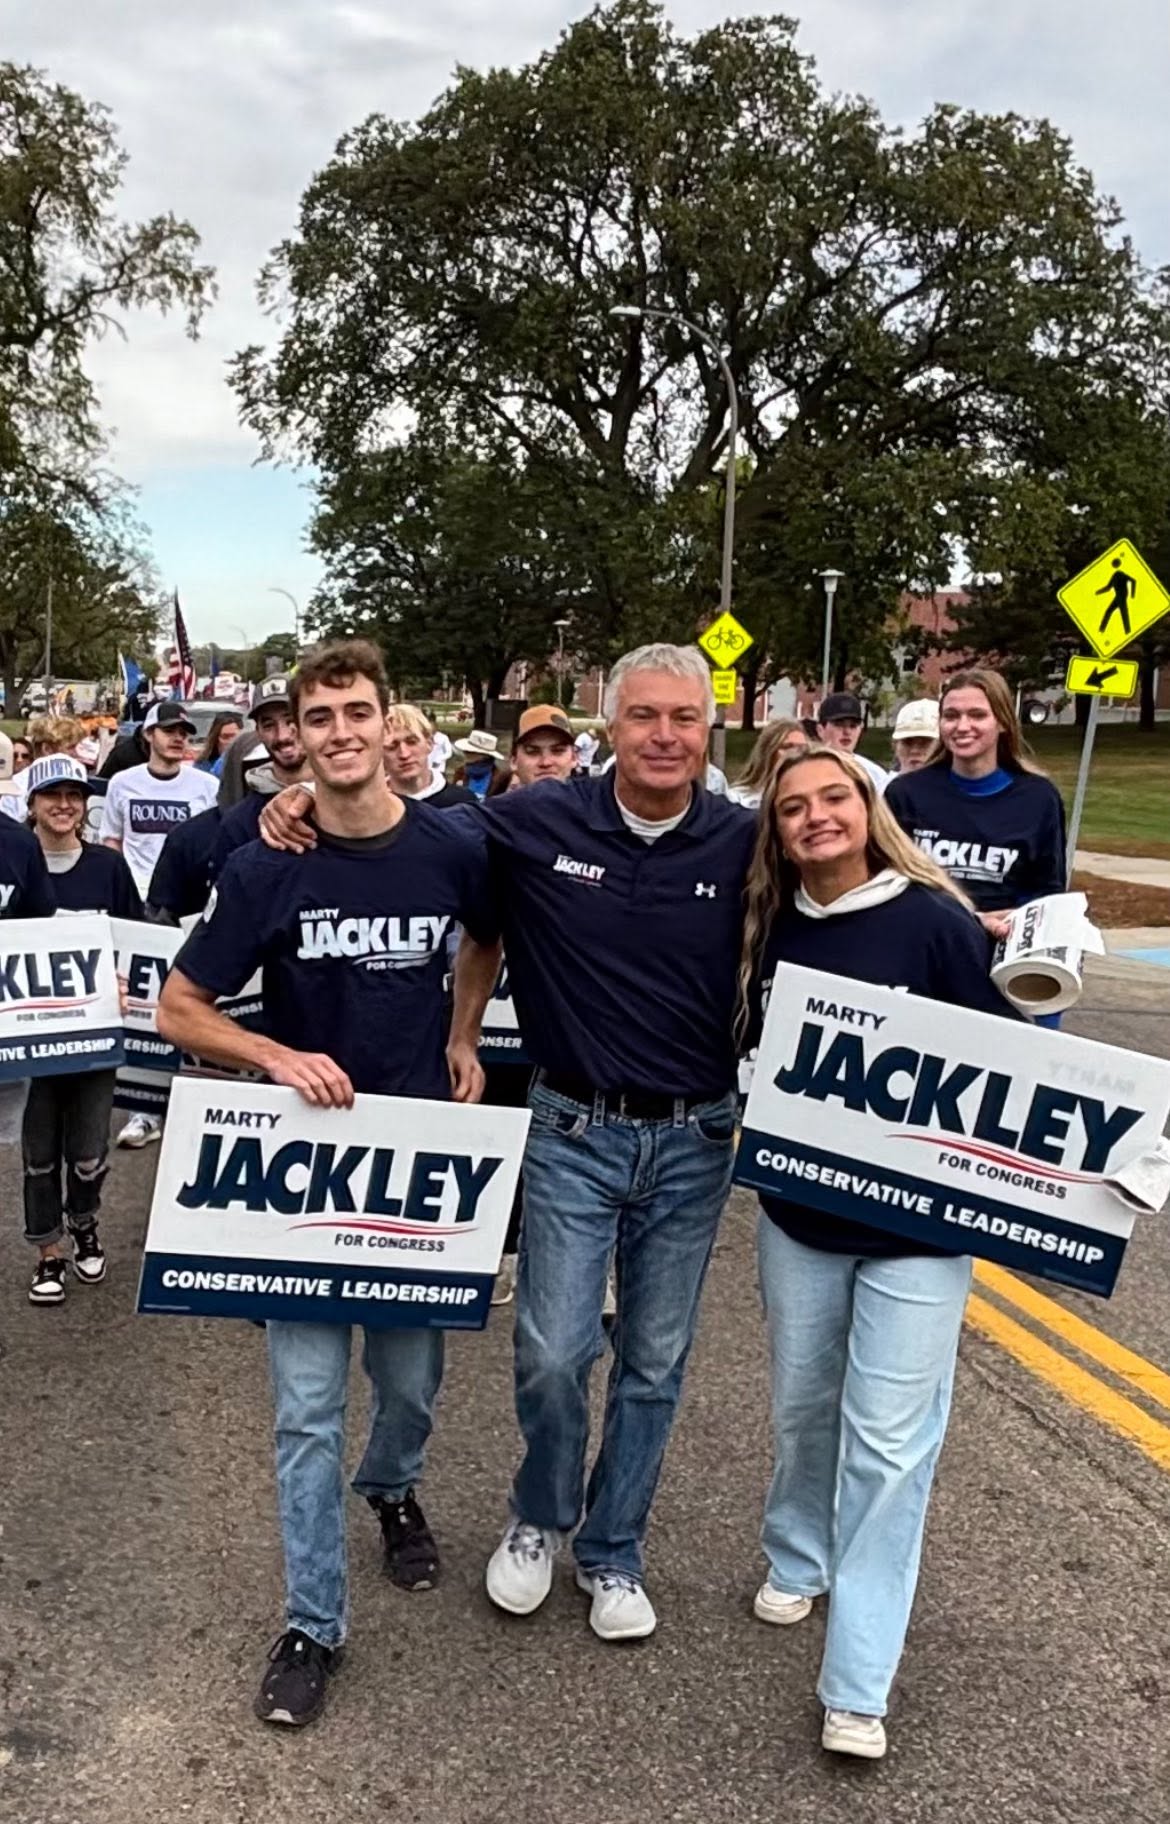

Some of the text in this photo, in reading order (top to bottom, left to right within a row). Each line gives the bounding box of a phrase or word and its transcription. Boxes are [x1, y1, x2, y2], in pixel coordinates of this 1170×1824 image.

[131, 804, 188, 822] ROUNDS
[300, 908, 339, 921] MARTY
[297, 915, 451, 960] JACKLEY
[805, 997, 888, 1031] MARTY
[31, 1037, 116, 1059] LEADERSHIP
[773, 1021, 1146, 1175] JACKLEY
[204, 1108, 282, 1130] MARTY
[176, 1133, 505, 1224] JACKLEY
[938, 1152, 1068, 1199] FOR CONGRESS
[755, 1148, 1105, 1265] CONSERVATIVE LEADERSHIP
[334, 1233, 446, 1253] FOR CONGRESS
[162, 1269, 479, 1306] CONSERVATIVE LEADERSHIP
